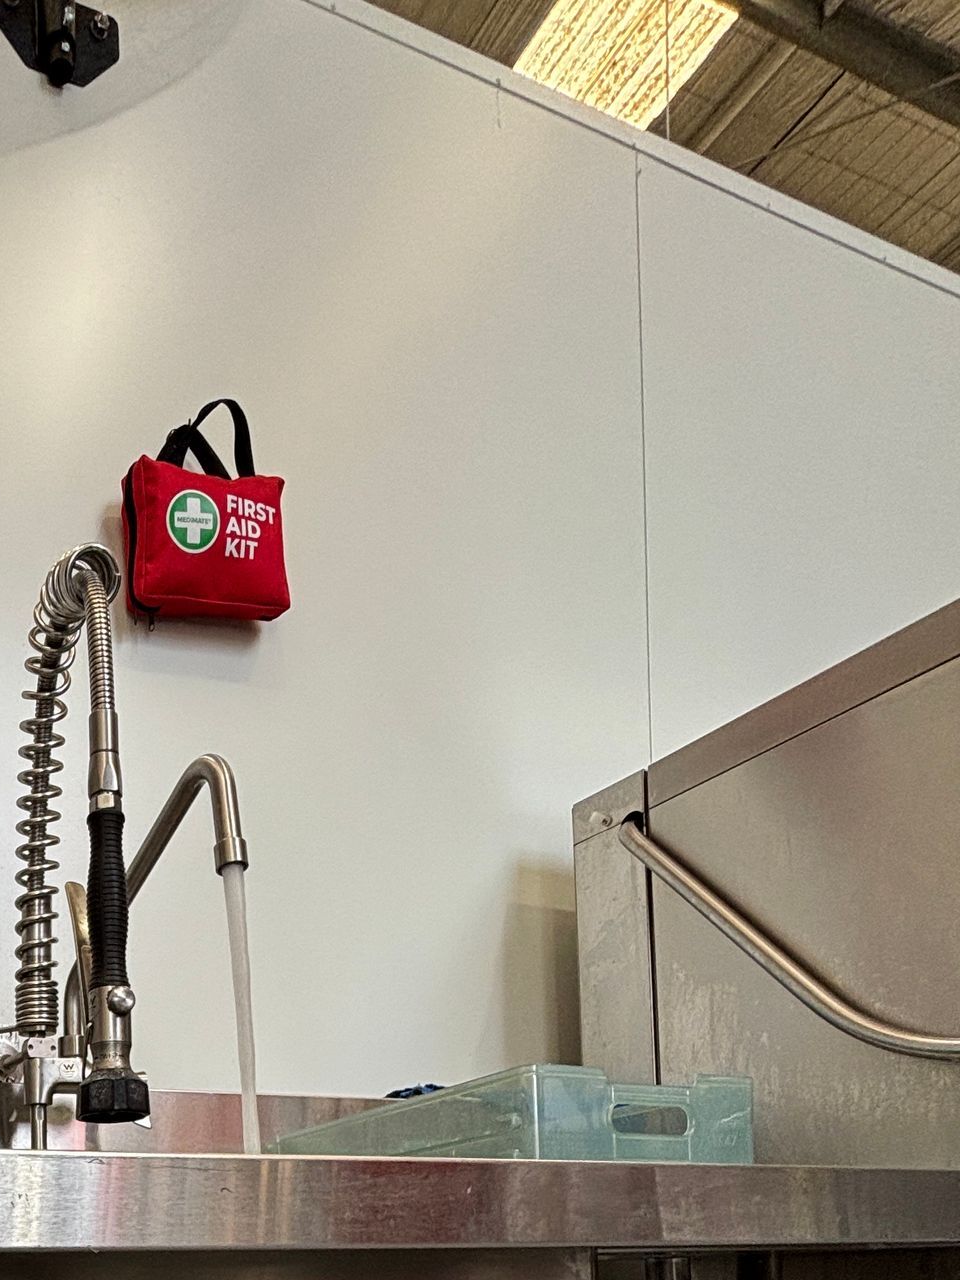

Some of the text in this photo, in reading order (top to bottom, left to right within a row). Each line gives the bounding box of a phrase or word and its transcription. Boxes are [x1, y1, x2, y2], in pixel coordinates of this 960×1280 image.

[227, 494, 276, 525] FIRST
[225, 516, 261, 539] AID
[225, 537, 259, 560] KIT
